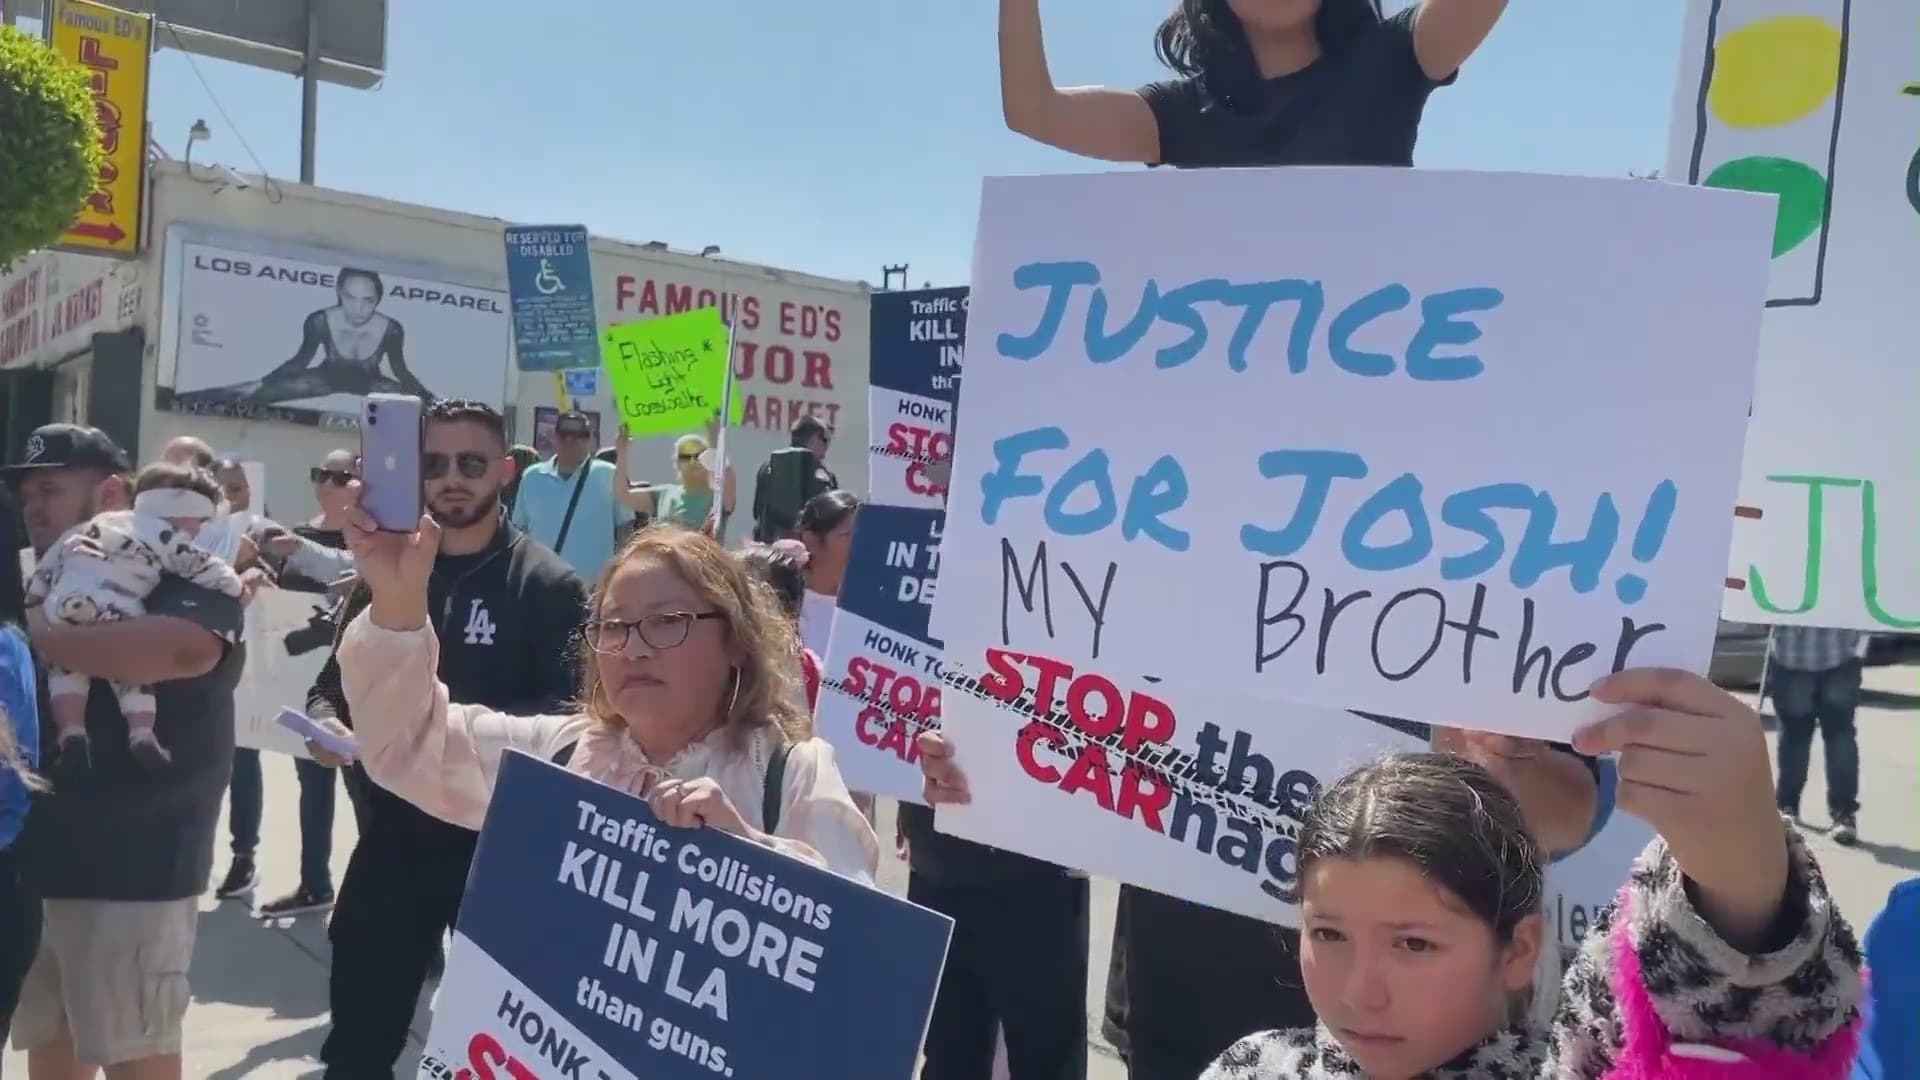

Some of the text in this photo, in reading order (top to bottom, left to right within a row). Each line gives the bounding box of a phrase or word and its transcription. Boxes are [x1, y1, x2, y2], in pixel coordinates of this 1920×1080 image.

[506, 231, 586, 244] RESERVED FOR
[520, 244, 573, 257] DISABLED
[194, 255, 504, 314] LOS ANGE APPAREL
[910, 297, 957, 315] Traffic
[779, 302, 841, 343] ED'S
[910, 319, 959, 341] KILL
[996, 260, 1505, 381] JUSTICE
[940, 344, 964, 367] IN
[741, 394, 841, 432] ARKET
[898, 399, 947, 424] HONK
[980, 426, 1677, 604] FOR JOSH!
[886, 541, 918, 568] IN
[463, 598, 496, 645] LA
[863, 629, 919, 667] HONK
[979, 647, 1320, 818] STOP the
[1015, 720, 1303, 906] CARnag
[576, 800, 833, 931] Traffic Collisions
[557, 841, 825, 993] KILL MORE
[603, 922, 730, 1022] IN LA
[497, 989, 591, 1080] HONK
[576, 976, 734, 1078] than guns.
